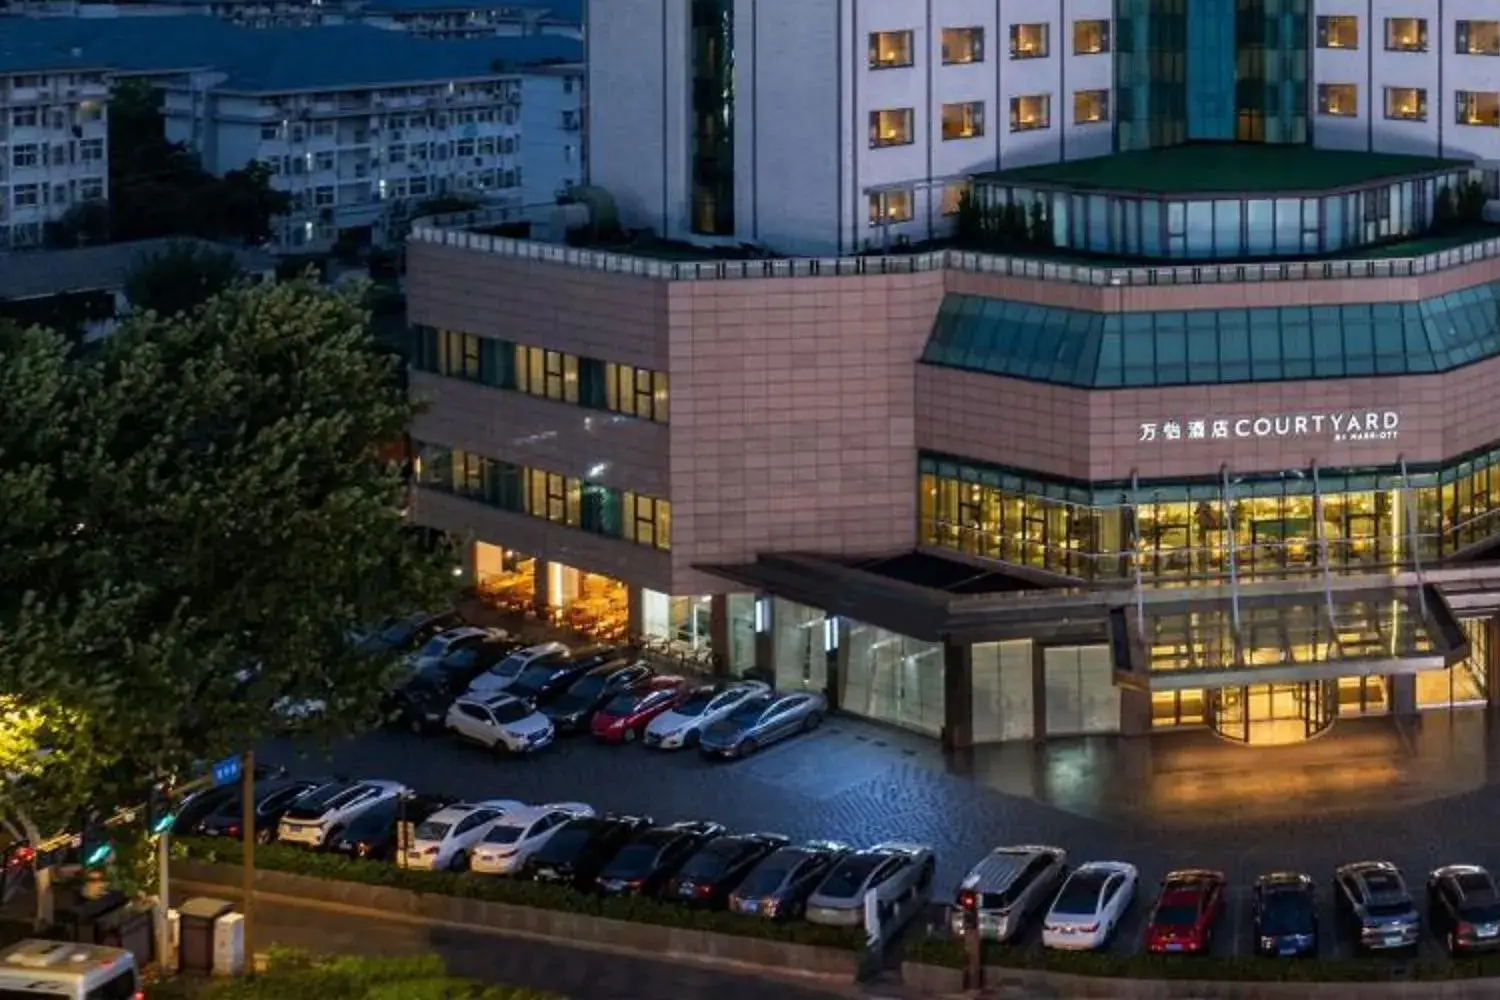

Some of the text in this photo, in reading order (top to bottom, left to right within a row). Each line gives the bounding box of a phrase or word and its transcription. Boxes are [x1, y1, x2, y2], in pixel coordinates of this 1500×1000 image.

[1139, 411, 1399, 442] 万怡酒店 COURTYARD
